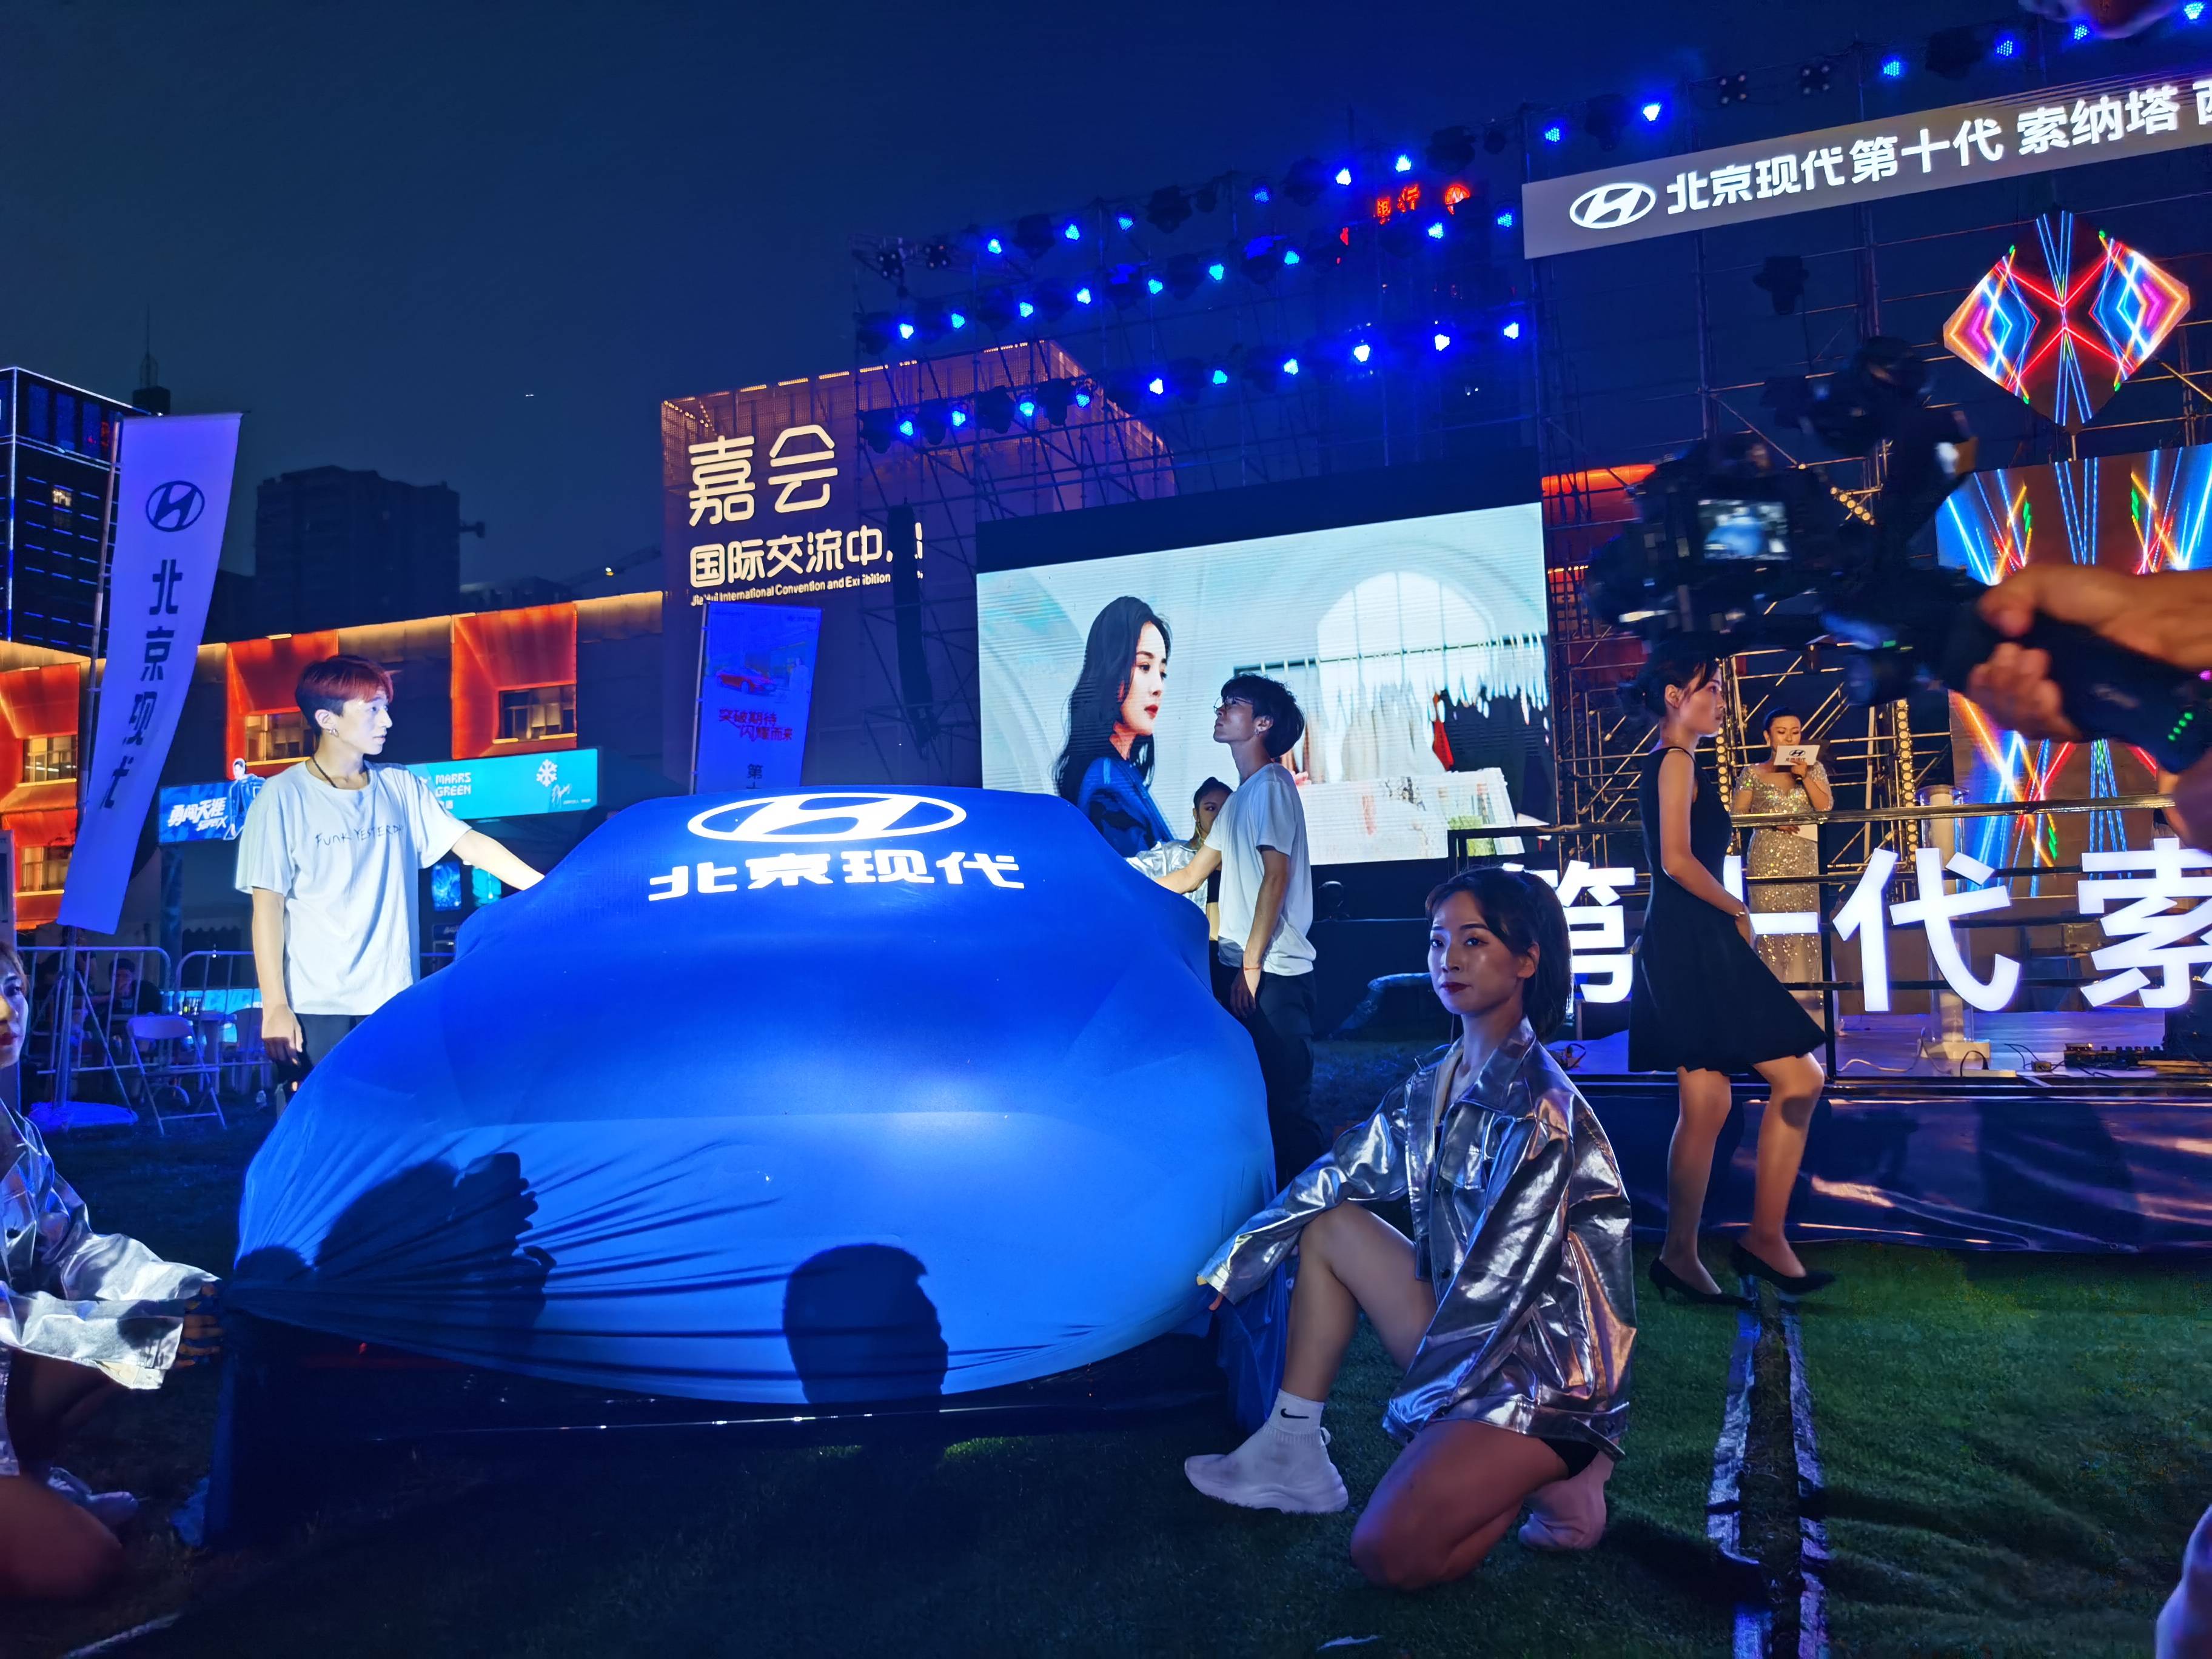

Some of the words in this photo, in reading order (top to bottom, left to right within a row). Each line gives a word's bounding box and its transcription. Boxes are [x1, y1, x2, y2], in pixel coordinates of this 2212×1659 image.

[1666, 118, 2004, 215] 北京现代第十代
[2017, 84, 2181, 156] 索纳塔
[688, 423, 839, 528] 嘉会
[719, 586, 774, 602] International
[775, 580, 826, 596] Convention
[827, 578, 845, 590] and
[718, 708, 777, 726] 突破期待
[435, 772, 472, 785] MARRS
[435, 785, 472, 798] GREEN
[648, 849, 1025, 902] 北京现代
